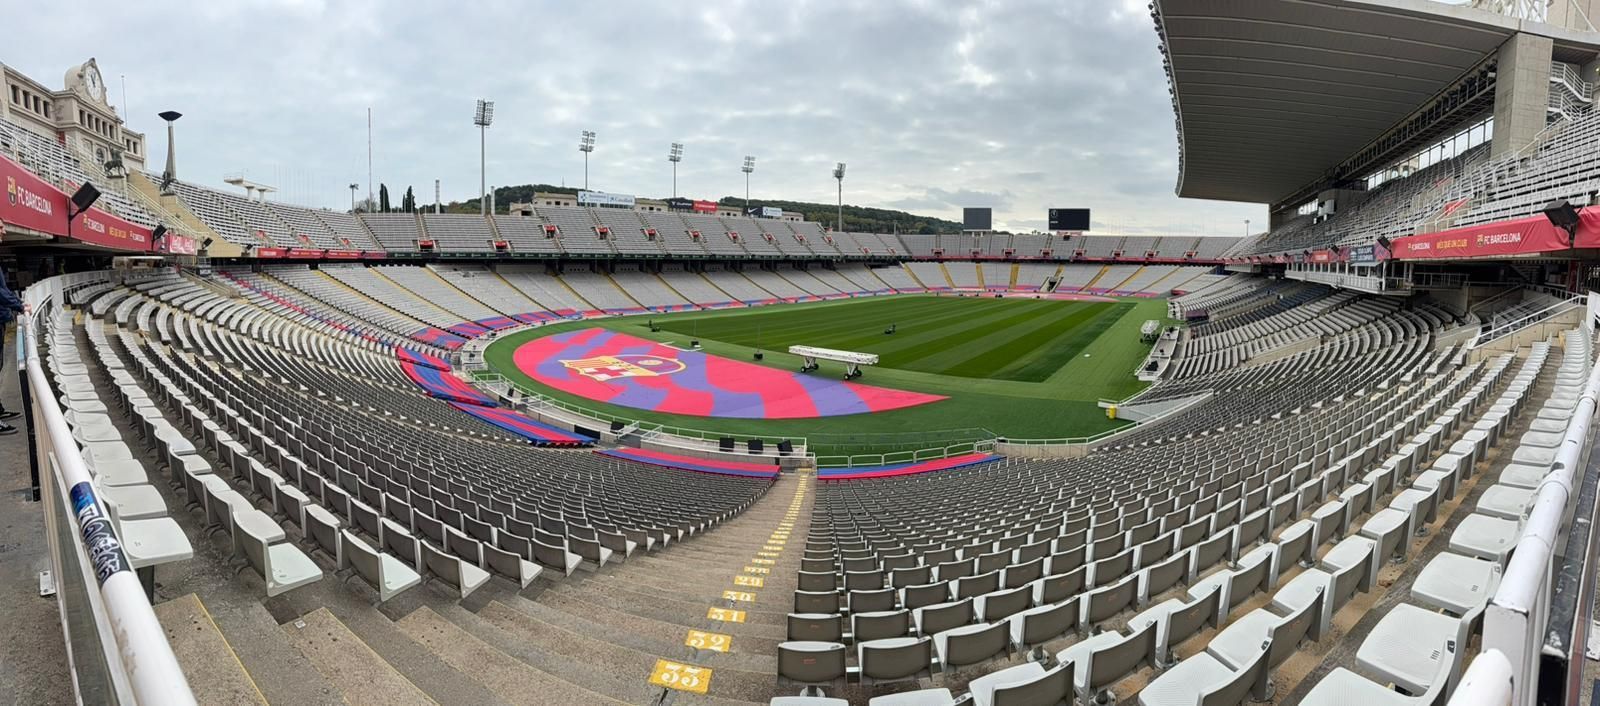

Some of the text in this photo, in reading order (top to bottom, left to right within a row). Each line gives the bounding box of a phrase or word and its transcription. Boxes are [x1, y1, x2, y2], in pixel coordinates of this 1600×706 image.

[18, 186, 52, 216] FC BARCELONA
[1484, 232, 1521, 245] FC BARCELONA
[711, 608, 739, 622] 31
[690, 631, 725, 651] 32
[661, 662, 699, 687] 33
